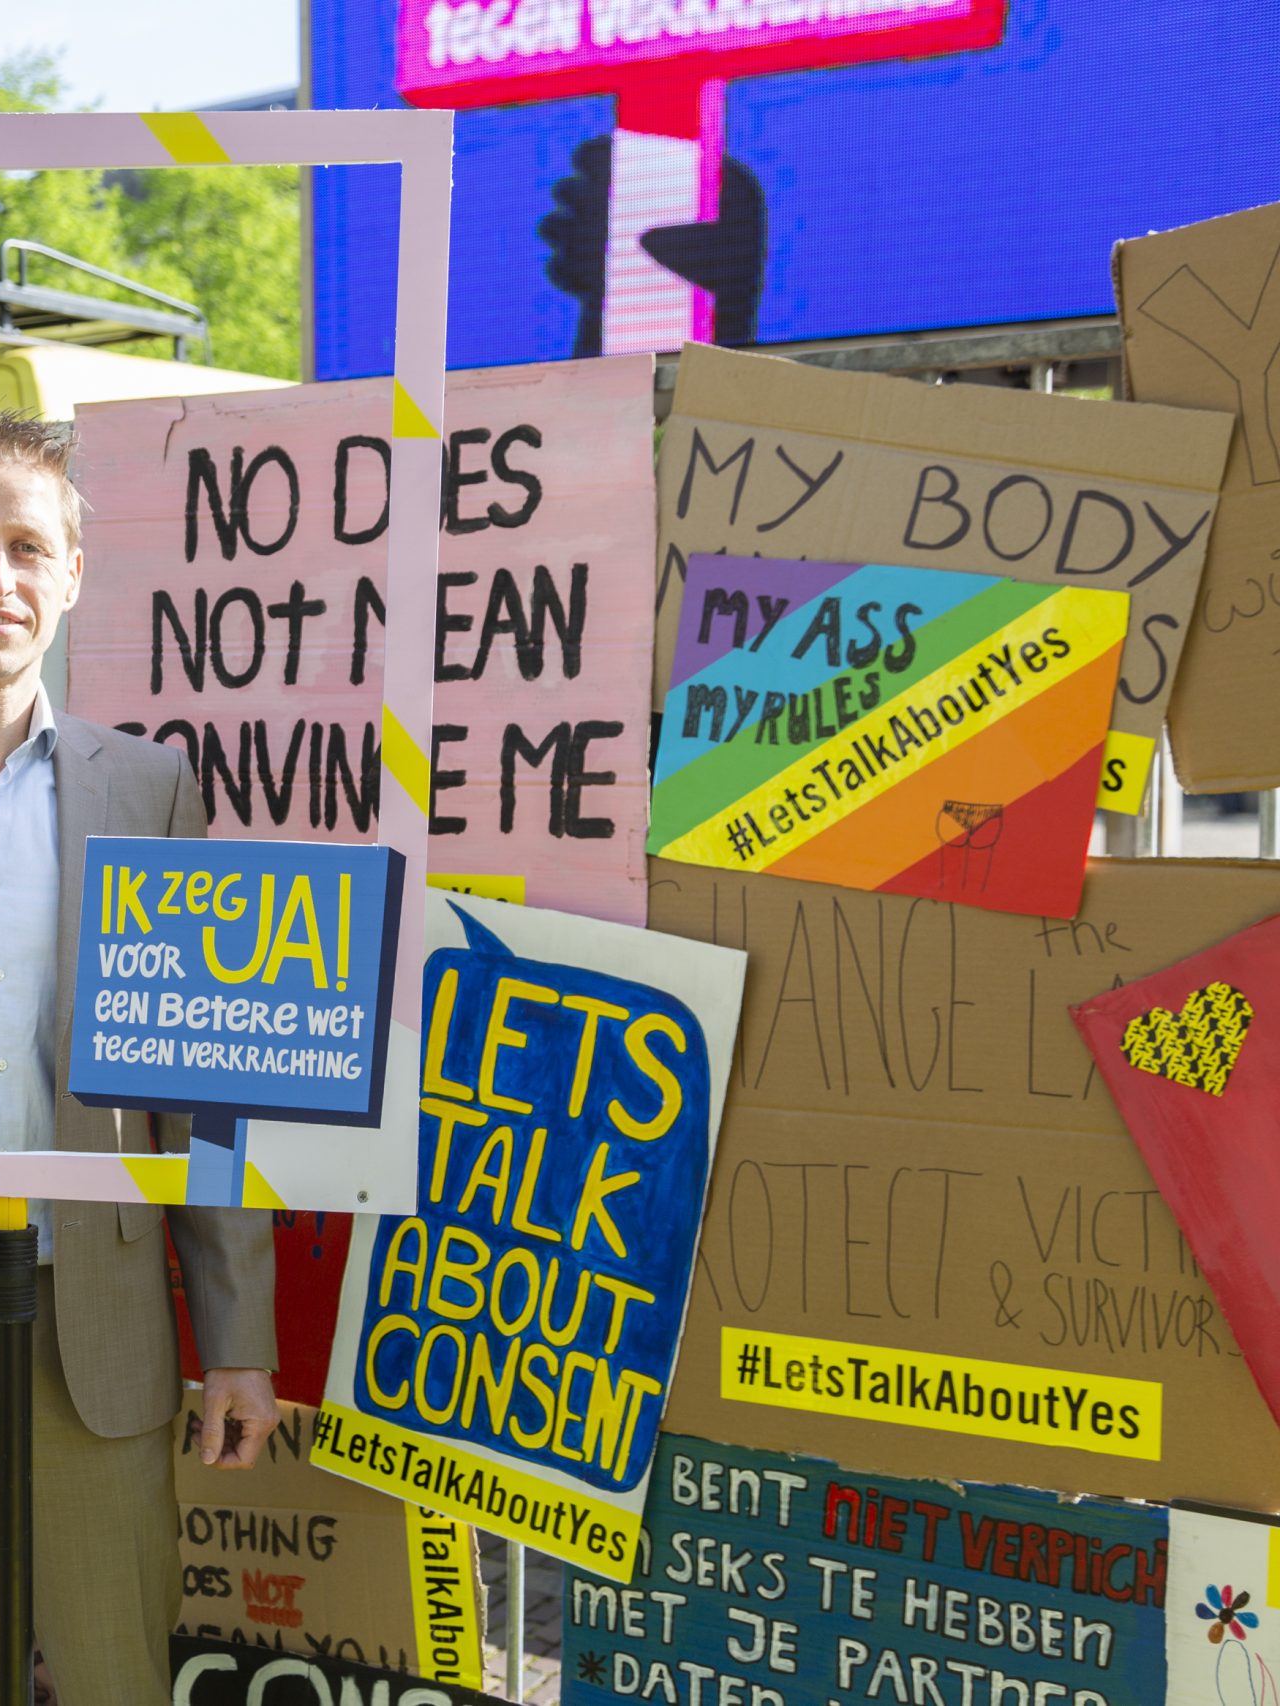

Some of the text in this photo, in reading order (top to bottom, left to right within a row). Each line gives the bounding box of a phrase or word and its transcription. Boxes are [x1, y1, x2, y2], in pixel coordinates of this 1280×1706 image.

[184, 445, 301, 564] NO
[676, 426, 844, 534] MY
[902, 463, 1211, 588] BODY
[789, 596, 925, 674] ASS
[499, 719, 625, 840] ME
[727, 626, 1072, 861] #LetsTalkAboutYes
[100, 864, 153, 935] IK
[201, 872, 353, 993] JA!
[422, 966, 688, 1143] LETS
[420, 1096, 642, 1259] TALK
[379, 1215, 657, 1355] ABOUT
[989, 1260, 1243, 1359] & SURVIVOR
[364, 1312, 663, 1482] CONSENT
[737, 1343, 1141, 1440] #LetsTalkAboutYes
[177, 1505, 339, 1562] OTHING
[317, 1409, 628, 1563] #LetsTalkAboutYes
[240, 1566, 307, 1608] NOT
[664, 1530, 788, 1602] SEKS
[806, 1555, 877, 1621] TE
[725, 1605, 800, 1675] JE
